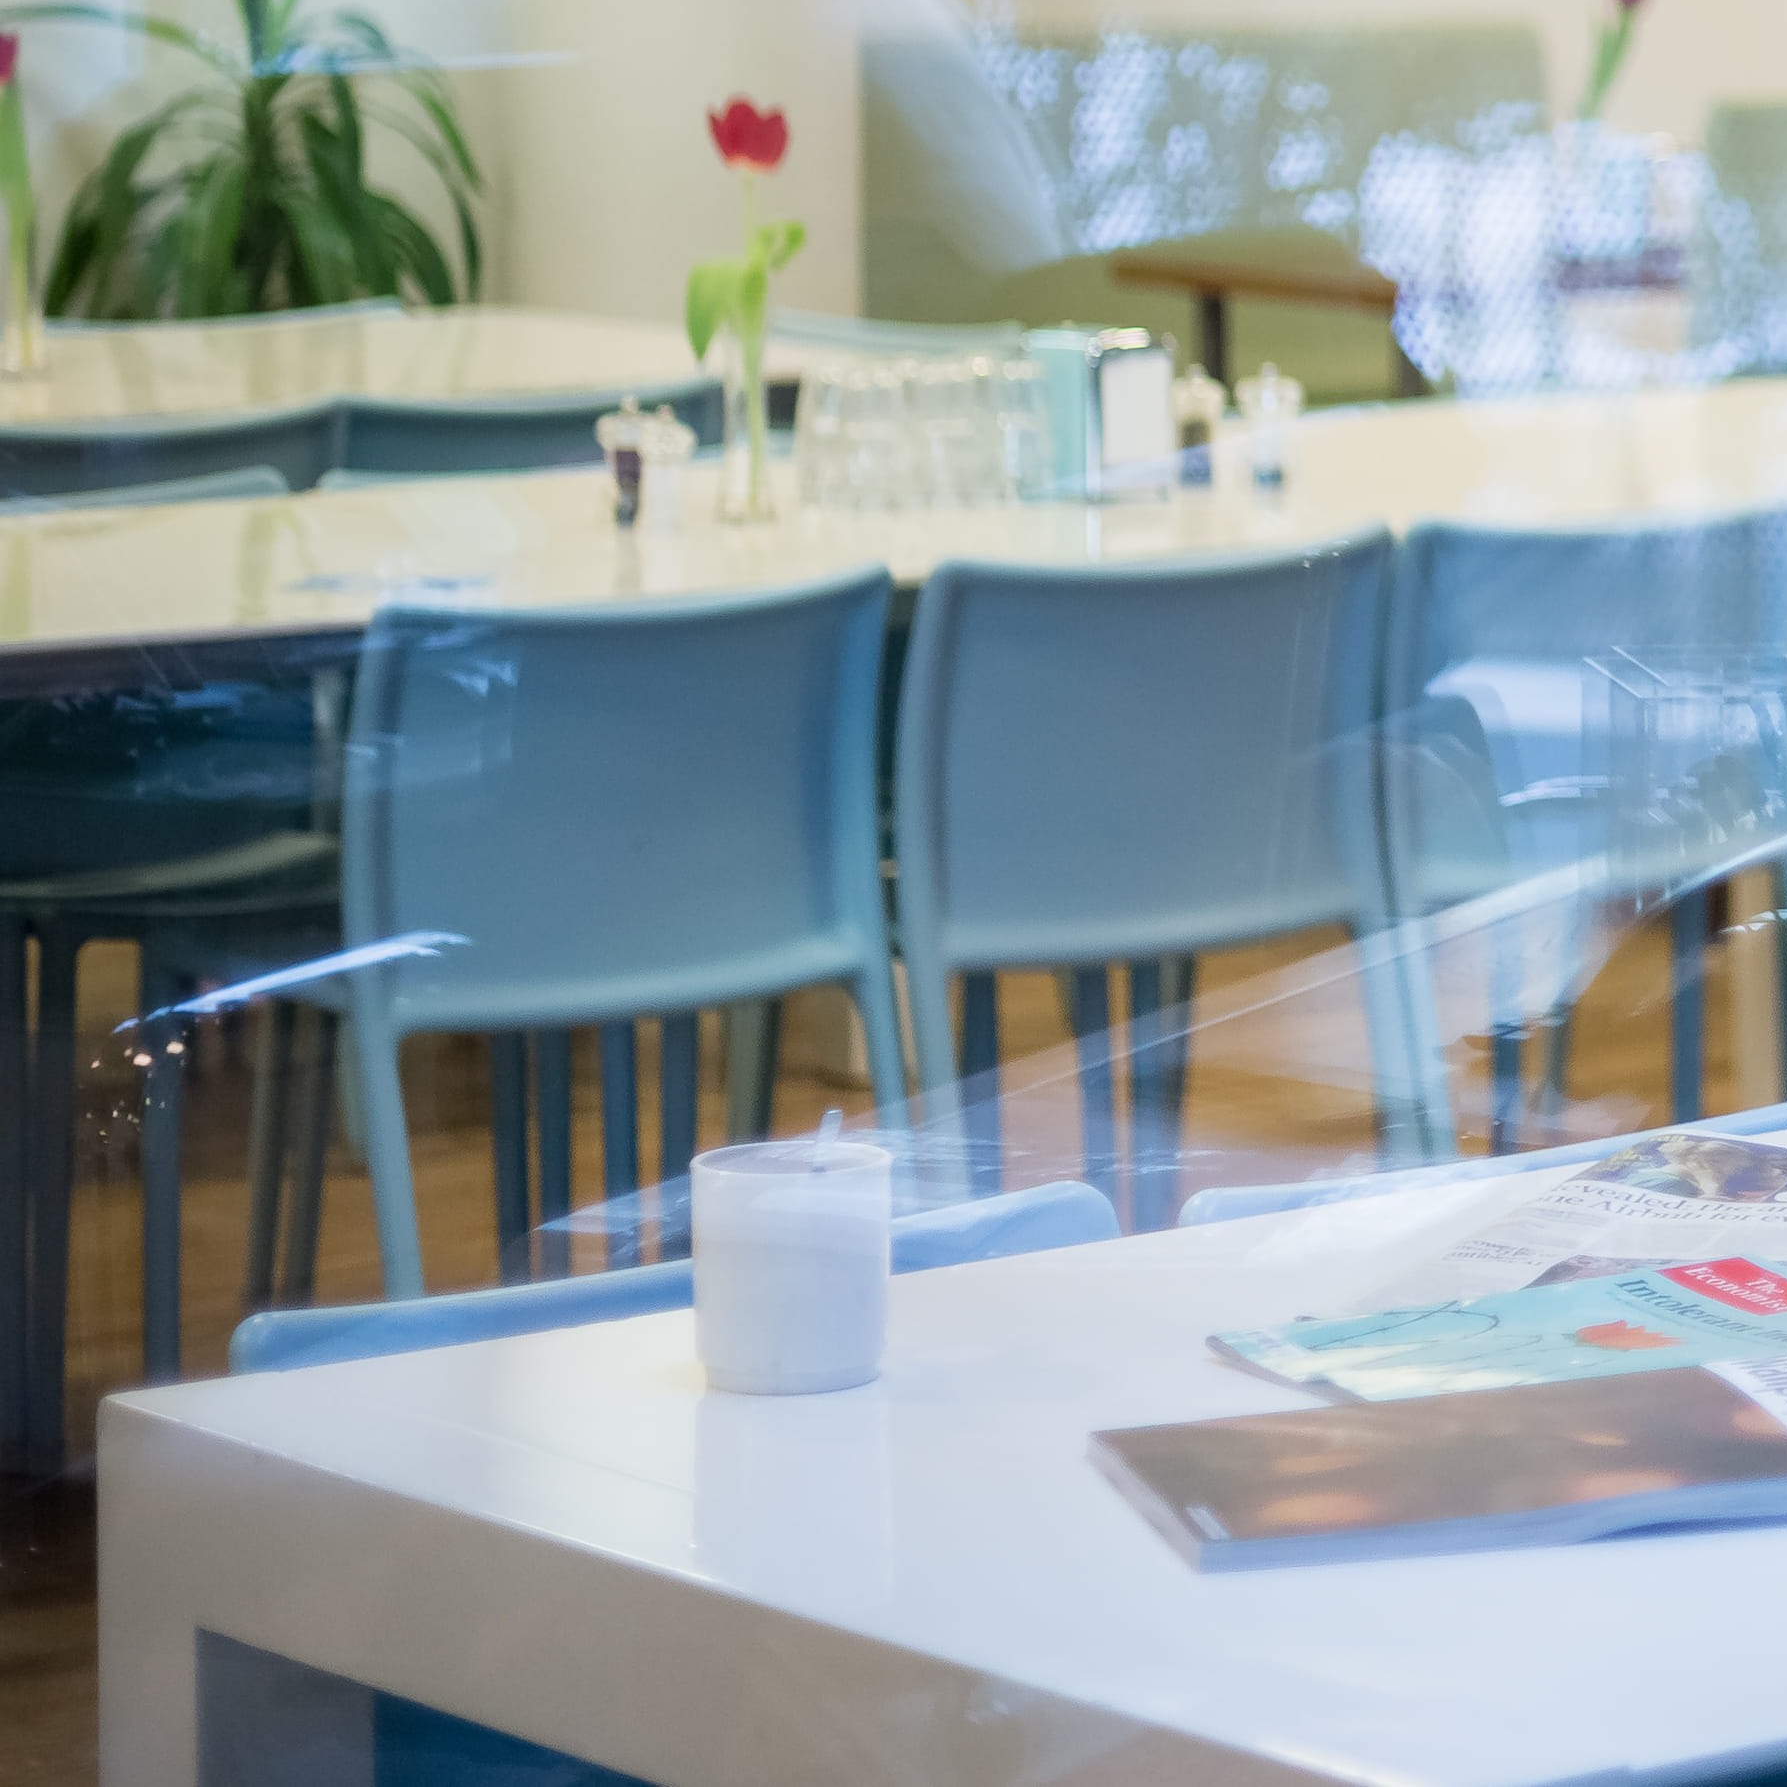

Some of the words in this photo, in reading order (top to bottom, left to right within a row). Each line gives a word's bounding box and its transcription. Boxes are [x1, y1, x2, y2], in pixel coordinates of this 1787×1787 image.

[1560, 1183, 1694, 1210] evealed:
[1589, 1199, 1701, 1221] Airbnb
[1702, 1210, 1752, 1221] for
[1746, 1278, 1784, 1295] The
[1616, 1279, 1763, 1332] Intolerant
